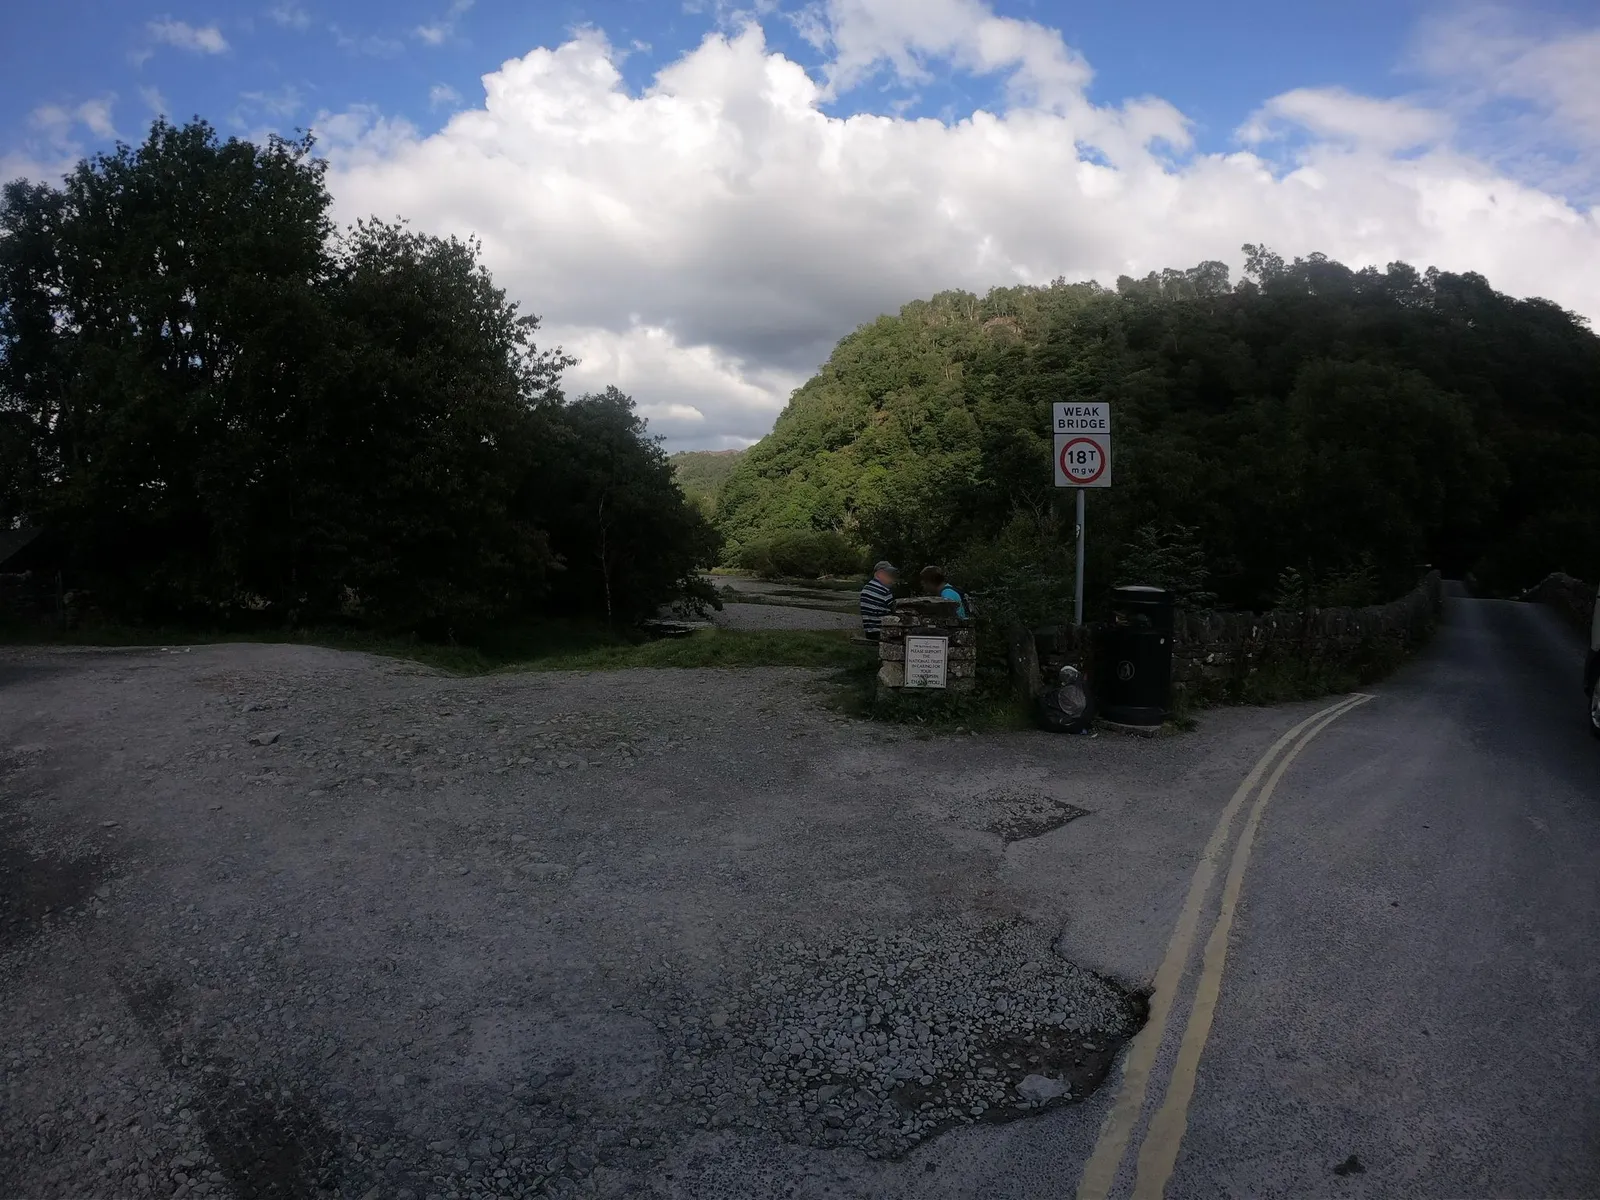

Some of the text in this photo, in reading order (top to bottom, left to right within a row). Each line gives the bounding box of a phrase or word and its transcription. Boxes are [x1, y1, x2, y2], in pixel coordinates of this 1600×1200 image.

[1063, 407, 1100, 417] WEAK
[1058, 419, 1106, 429] BRIDGE
[1068, 450, 1096, 464] 18T
